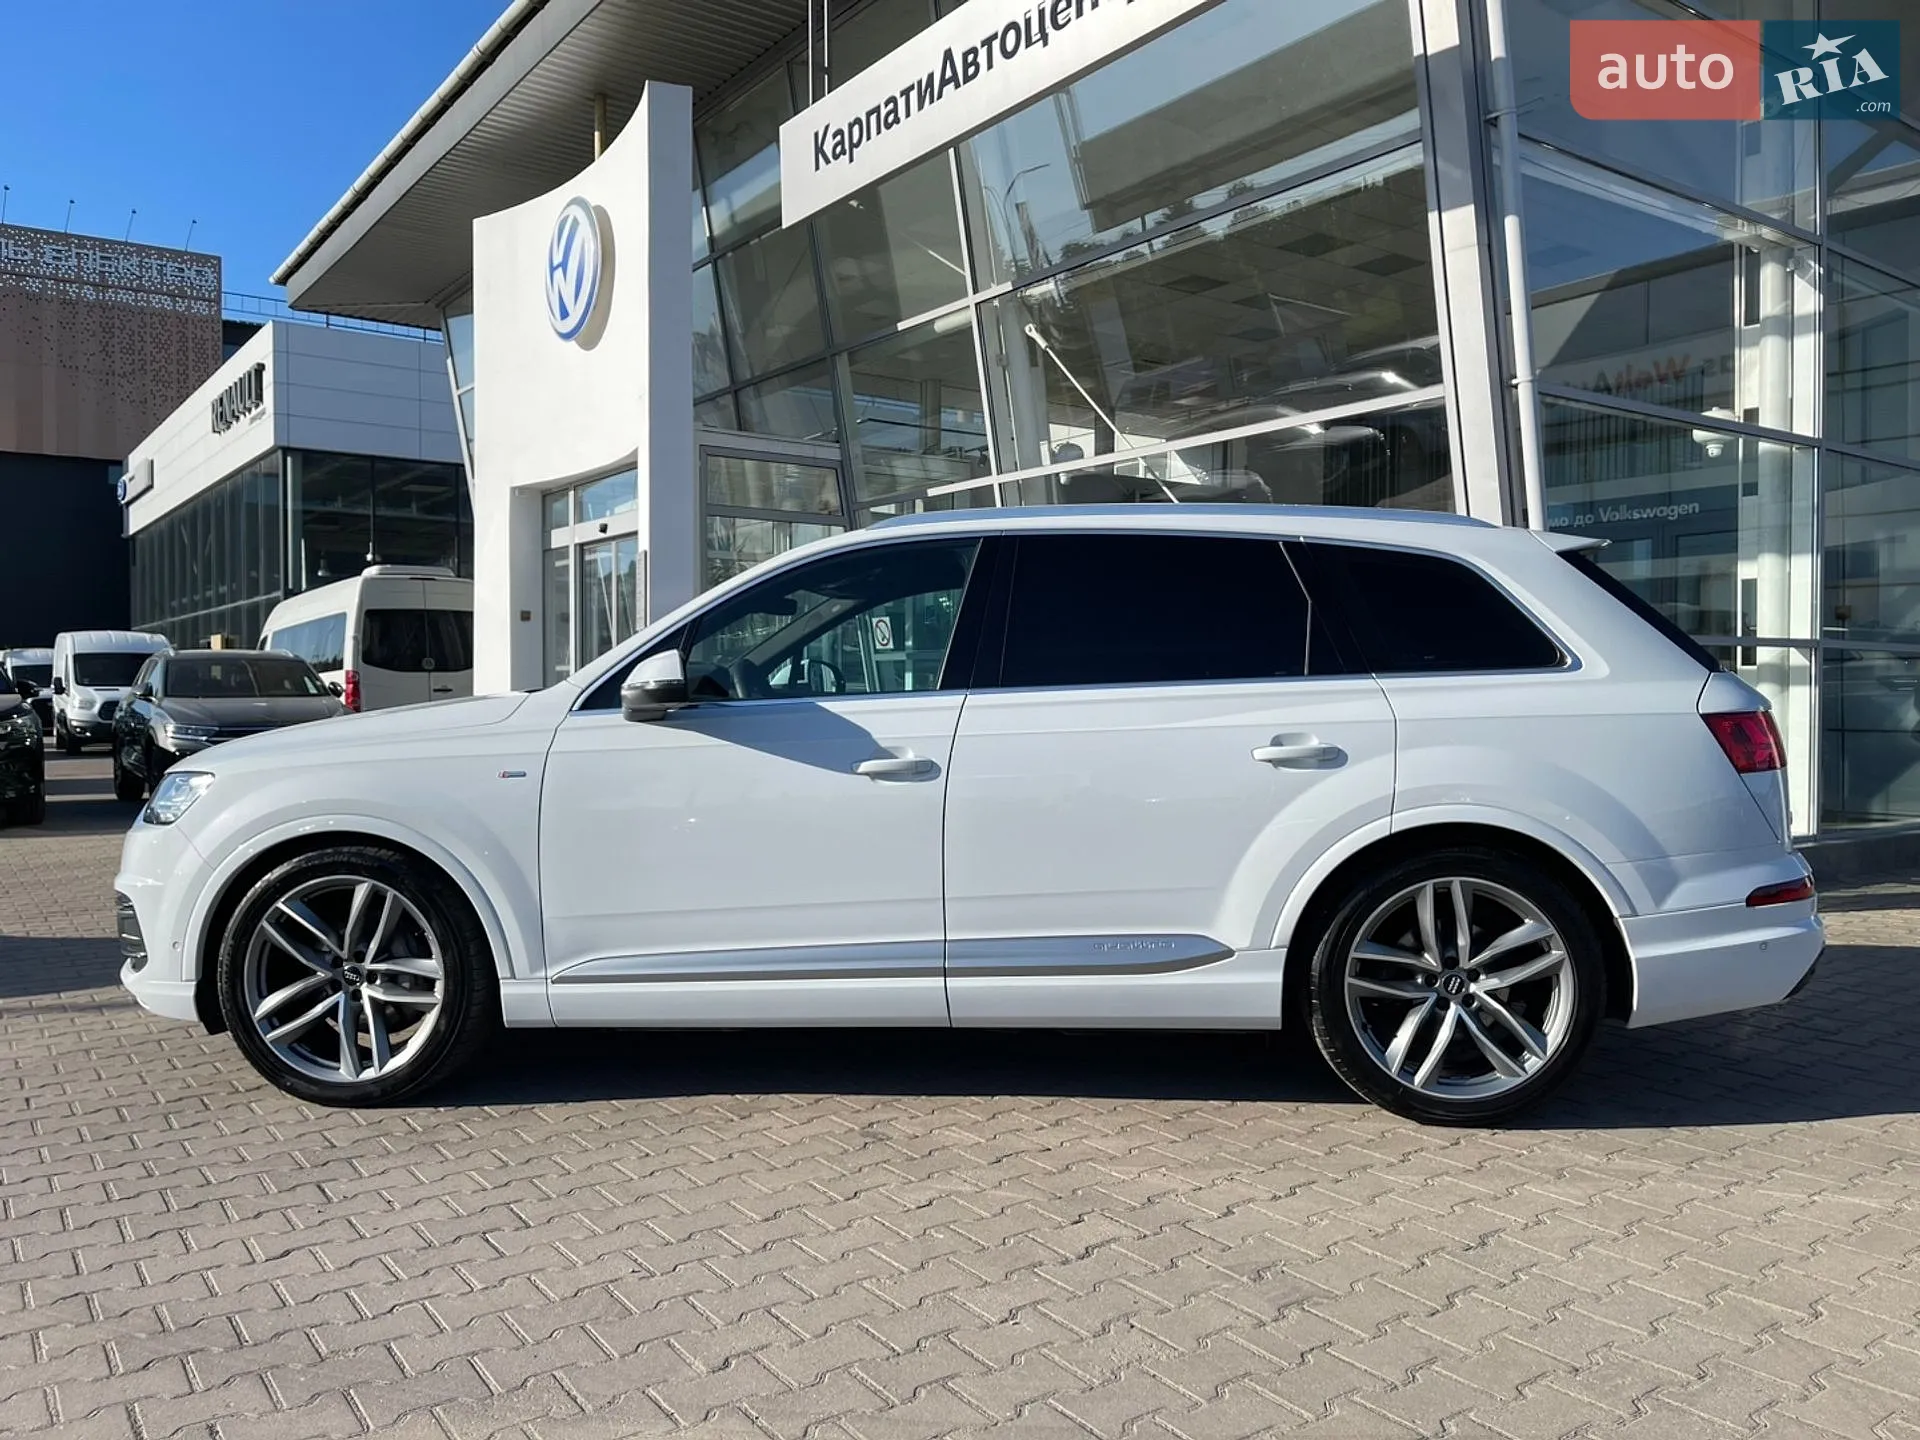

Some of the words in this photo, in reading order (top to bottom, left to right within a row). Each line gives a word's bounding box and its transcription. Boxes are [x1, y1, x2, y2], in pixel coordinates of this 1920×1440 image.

[813, 0, 1135, 172] КарпатиАвтоце
[1574, 513, 1595, 527] до
[1598, 502, 1700, 522] Volkswagen
